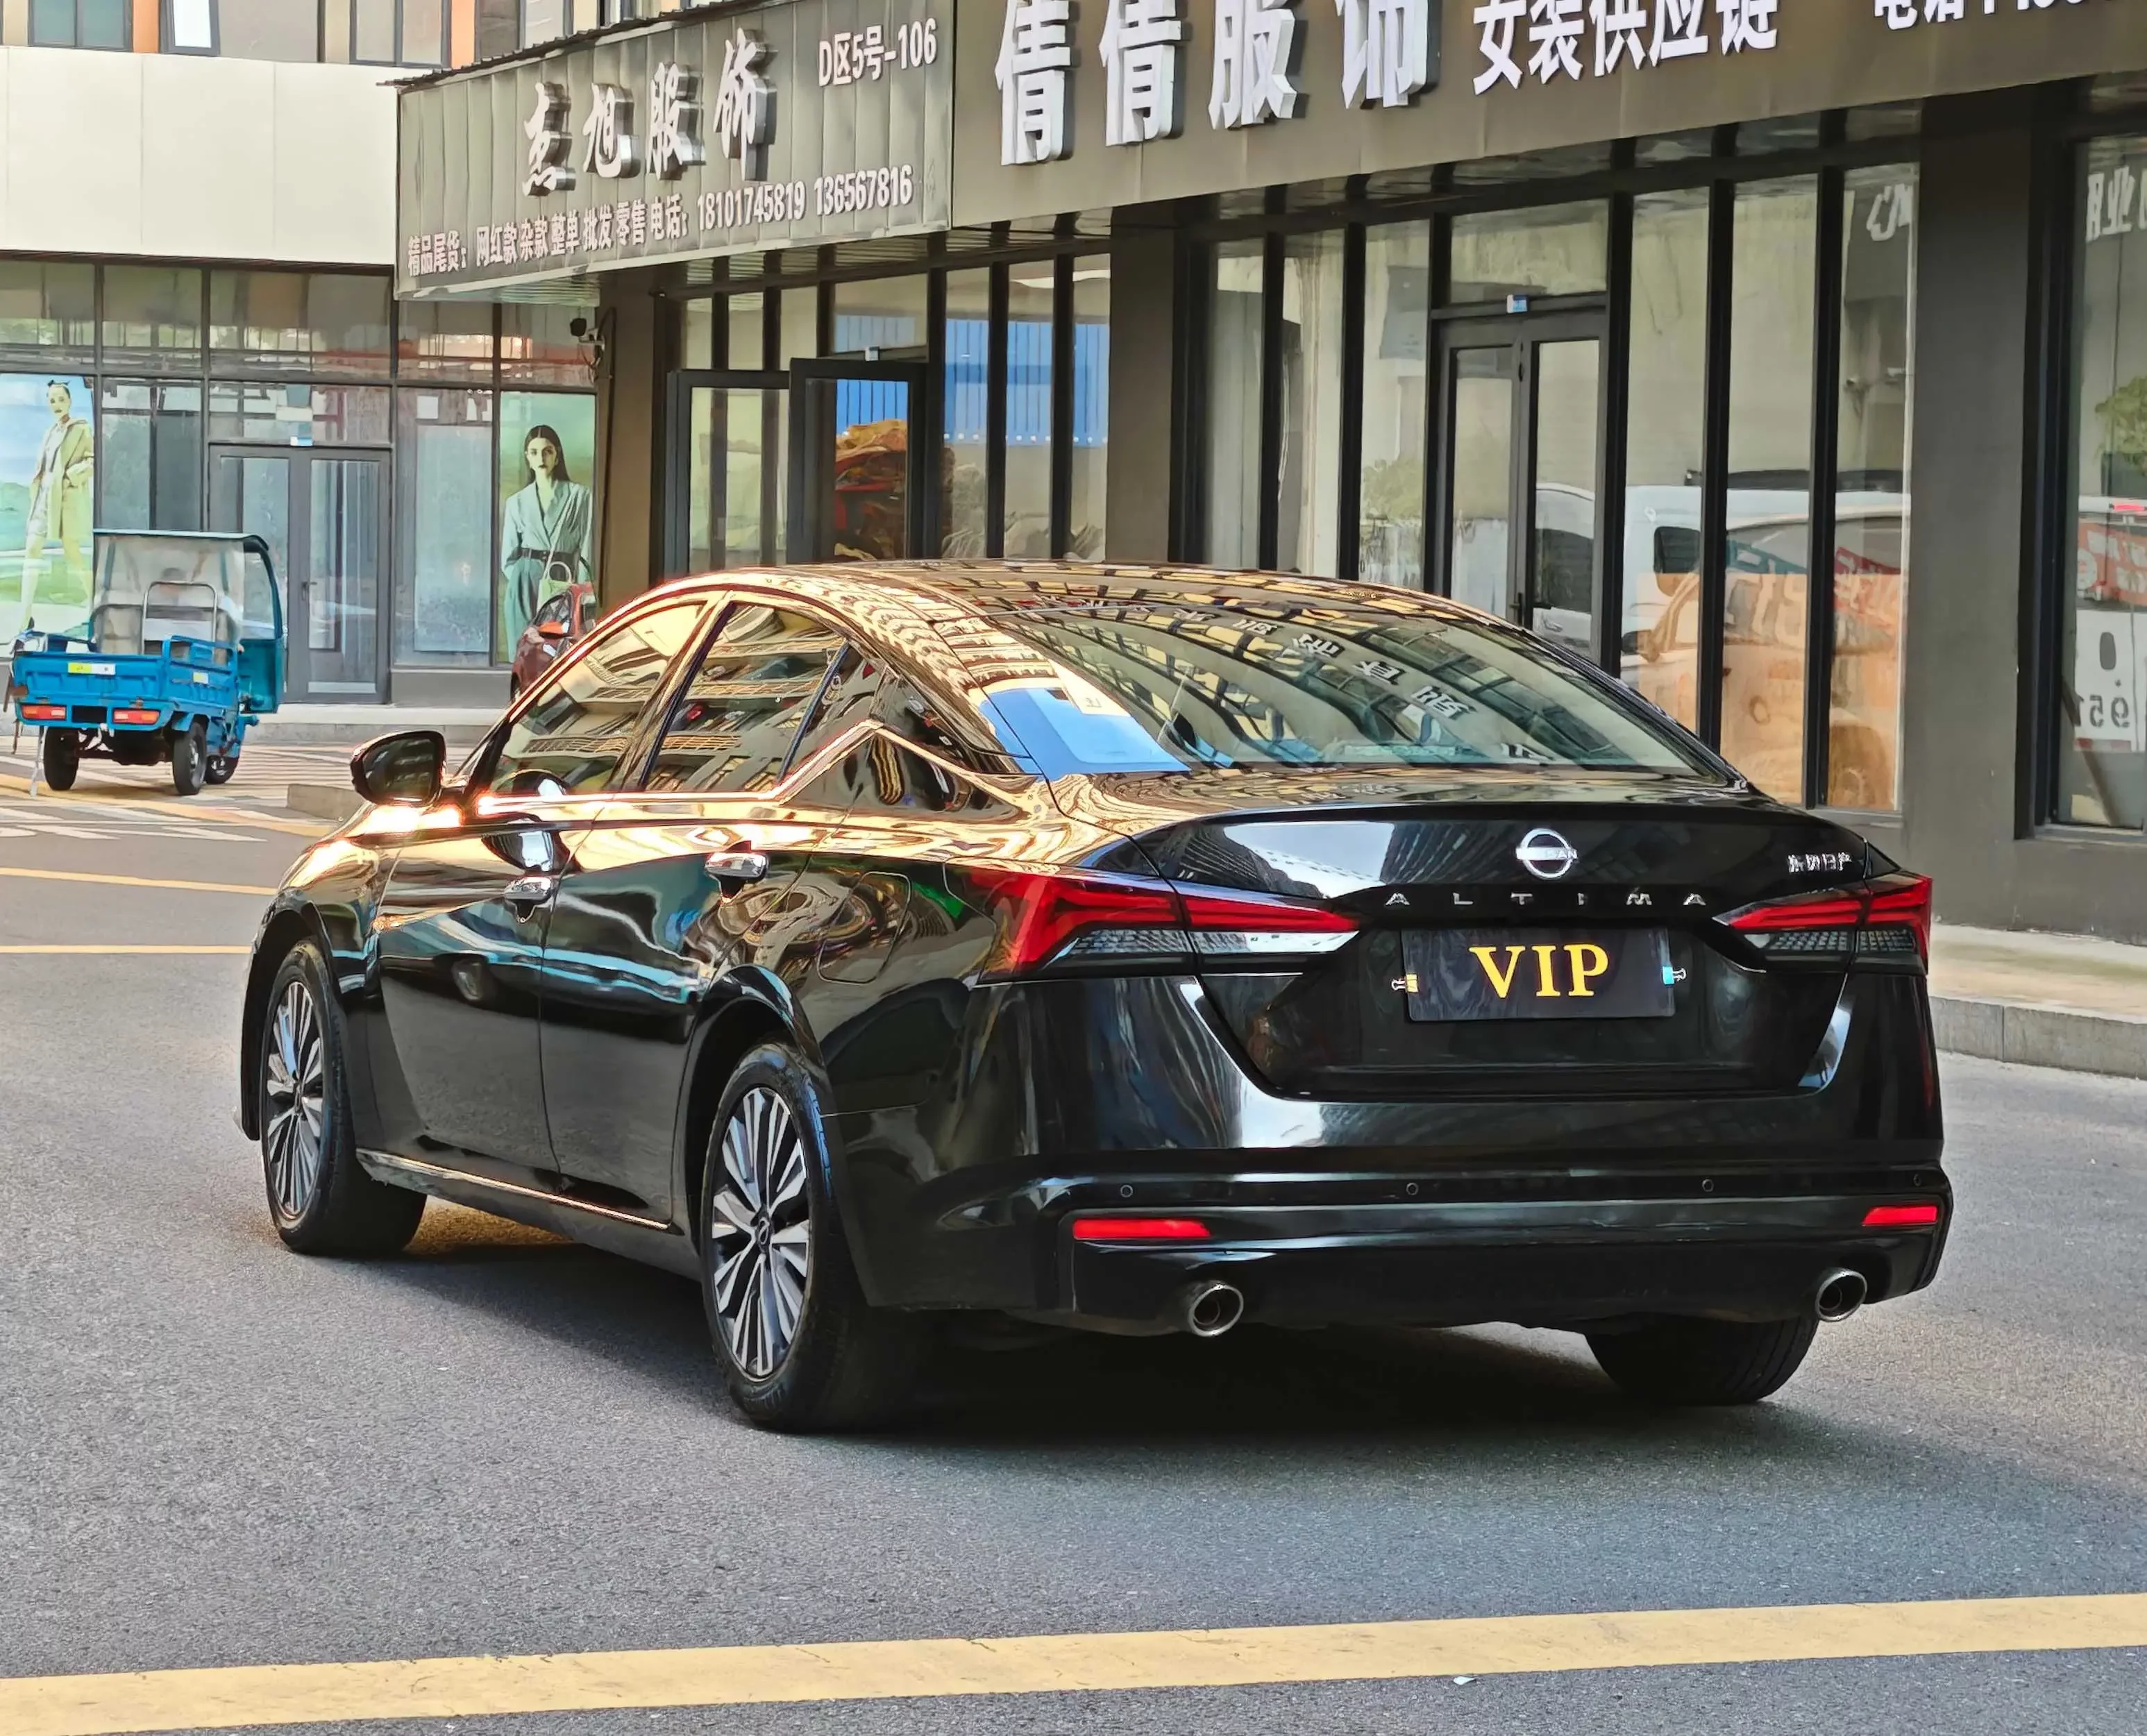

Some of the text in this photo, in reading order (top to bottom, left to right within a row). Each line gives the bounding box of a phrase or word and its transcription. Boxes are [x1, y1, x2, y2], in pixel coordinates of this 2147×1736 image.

[818, 17, 937, 87] D区5号-106
[476, 221, 519, 267] 网红款
[550, 209, 581, 256] 整单
[582, 204, 613, 252] 批发
[616, 200, 646, 246] 零售
[697, 180, 807, 232] 18101745819
[814, 164, 913, 217] 136567816
[1386, 891, 1707, 905] ALTIMA
[1469, 943, 1610, 999] VIP
